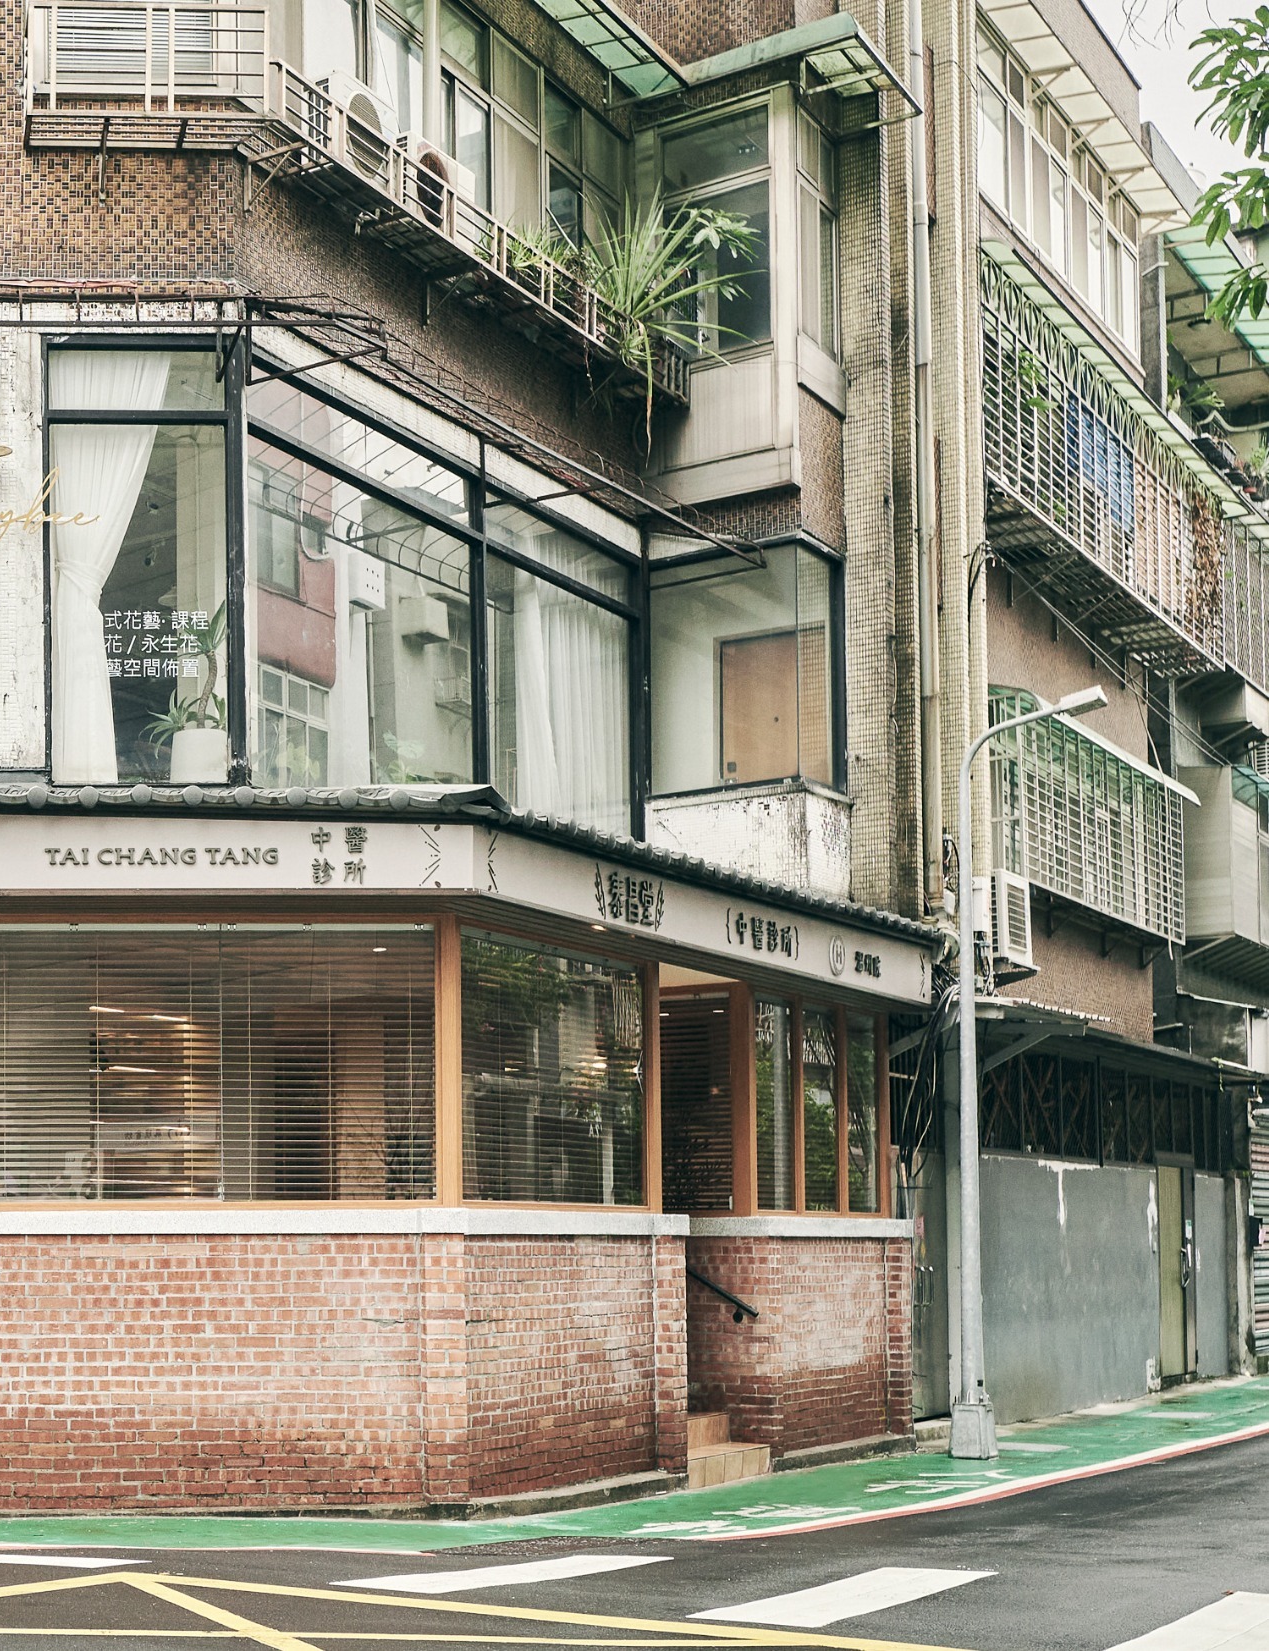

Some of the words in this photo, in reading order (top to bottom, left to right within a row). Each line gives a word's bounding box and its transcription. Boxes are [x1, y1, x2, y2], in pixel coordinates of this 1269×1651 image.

[171, 610, 209, 630] 課程
[141, 633, 198, 653] 永生花
[107, 658, 199, 678] 藝空間佈置
[311, 826, 368, 853] 中醫
[44, 847, 89, 866] TAI
[97, 847, 197, 866] CHANG
[205, 847, 280, 866] TANG
[311, 857, 367, 885] 診所
